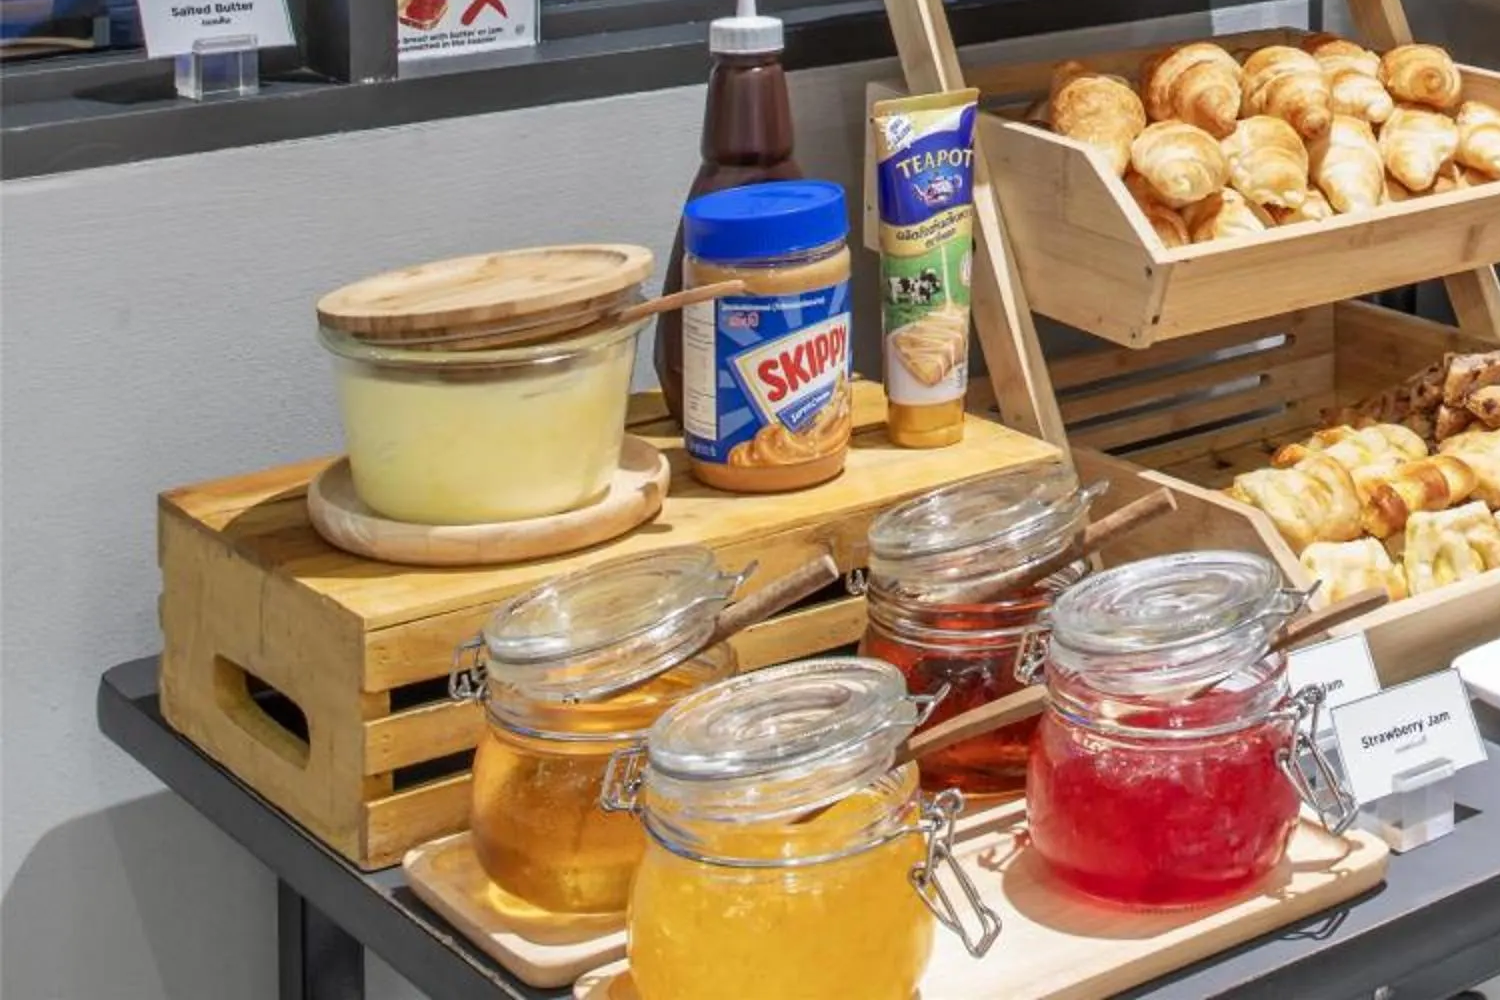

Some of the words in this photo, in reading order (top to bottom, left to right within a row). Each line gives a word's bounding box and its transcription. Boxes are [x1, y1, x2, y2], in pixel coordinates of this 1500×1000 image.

[171, 4, 211, 17] Salted
[215, 2, 253, 13] Butter
[895, 148, 973, 179] TEAPOT
[757, 322, 847, 403] SKIPPY
[1361, 719, 1423, 749] Strawberry
[1427, 711, 1451, 727] Jam
